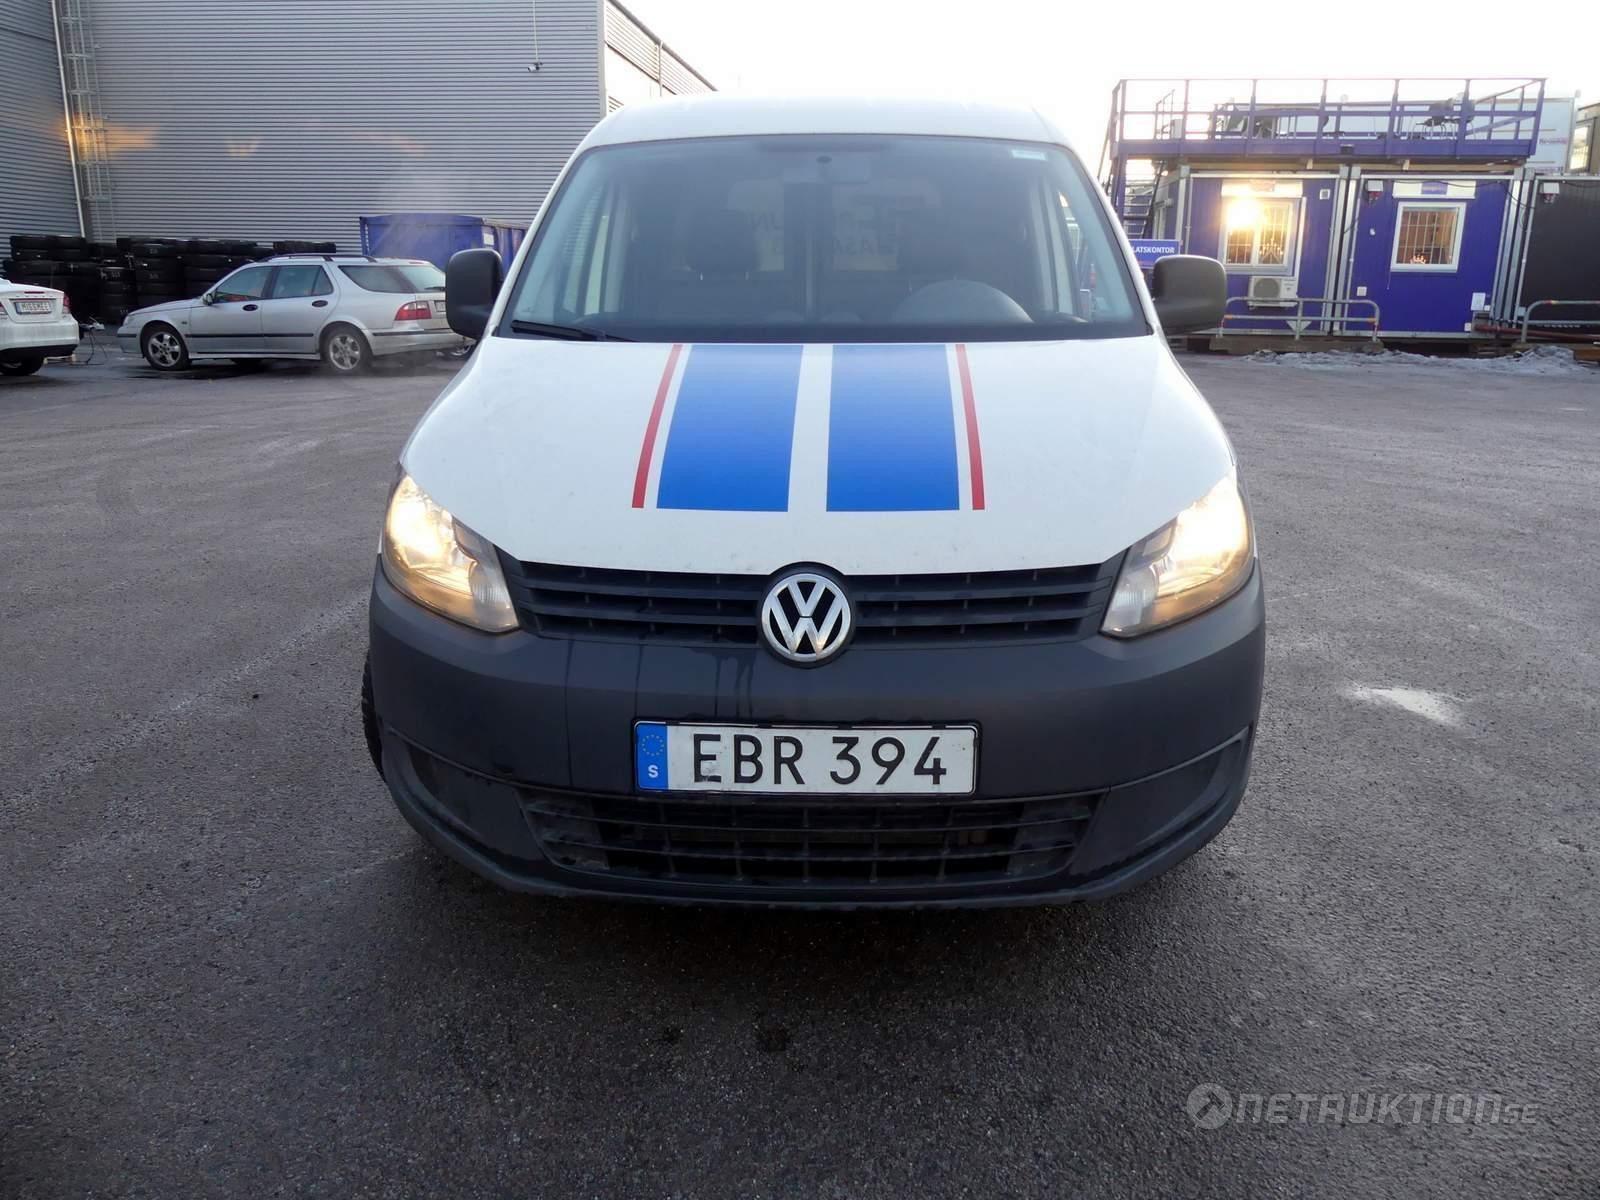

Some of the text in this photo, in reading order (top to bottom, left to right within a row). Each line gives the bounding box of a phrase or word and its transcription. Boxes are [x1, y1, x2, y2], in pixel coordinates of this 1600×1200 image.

[761, 574, 851, 662] VW
[647, 766, 659, 779] S
[693, 734, 948, 786] EBR 394
